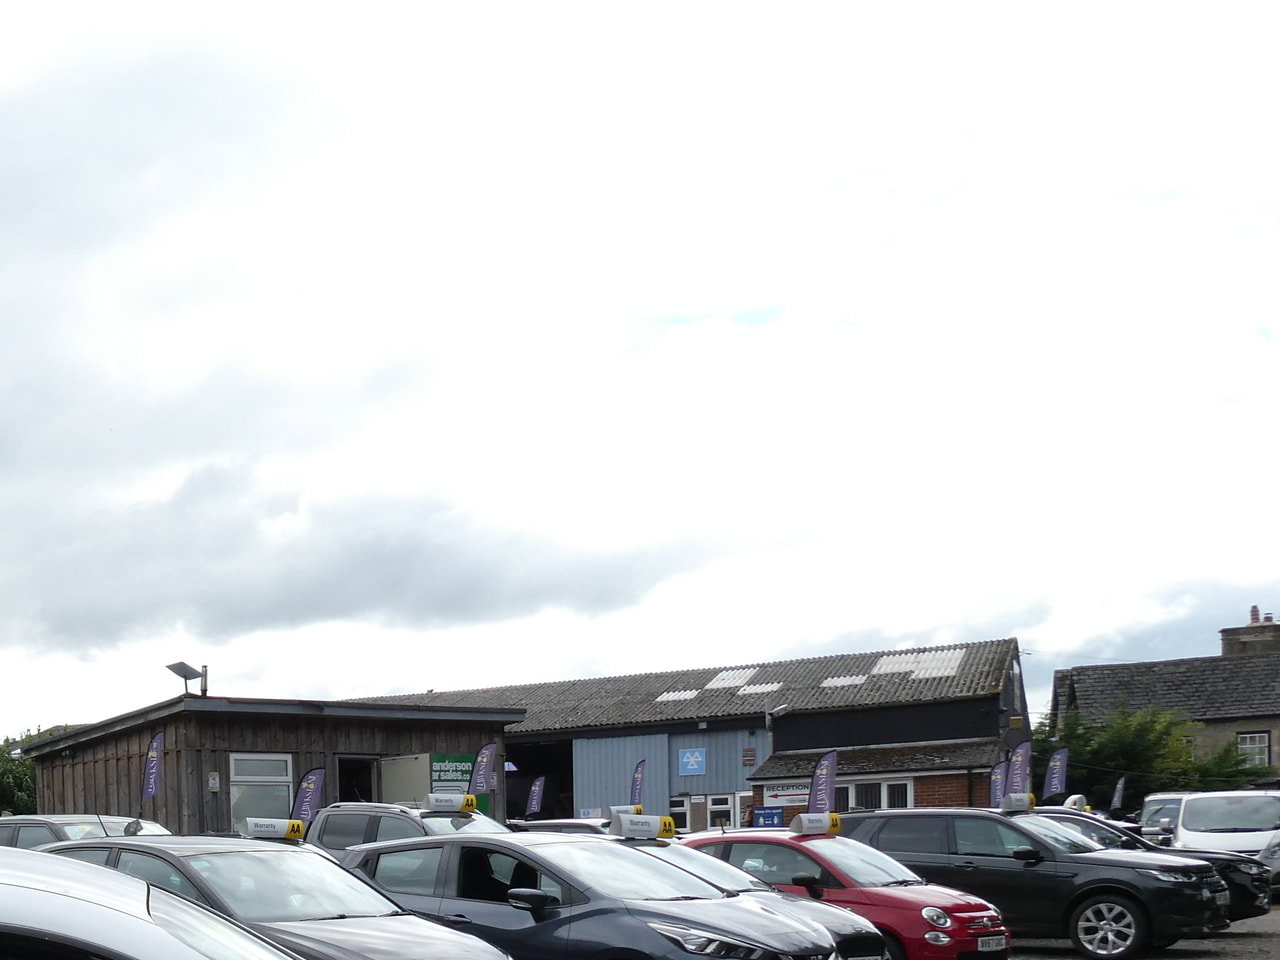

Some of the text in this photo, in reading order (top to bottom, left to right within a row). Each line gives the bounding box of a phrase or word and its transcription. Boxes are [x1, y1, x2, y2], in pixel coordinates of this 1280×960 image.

[432, 760, 472, 771] anderson
[766, 784, 809, 792] RECEPTION
[464, 799, 474, 808] AA
[254, 822, 276, 830] Warranty
[289, 823, 301, 834] AA
[662, 821, 672, 834] AA
